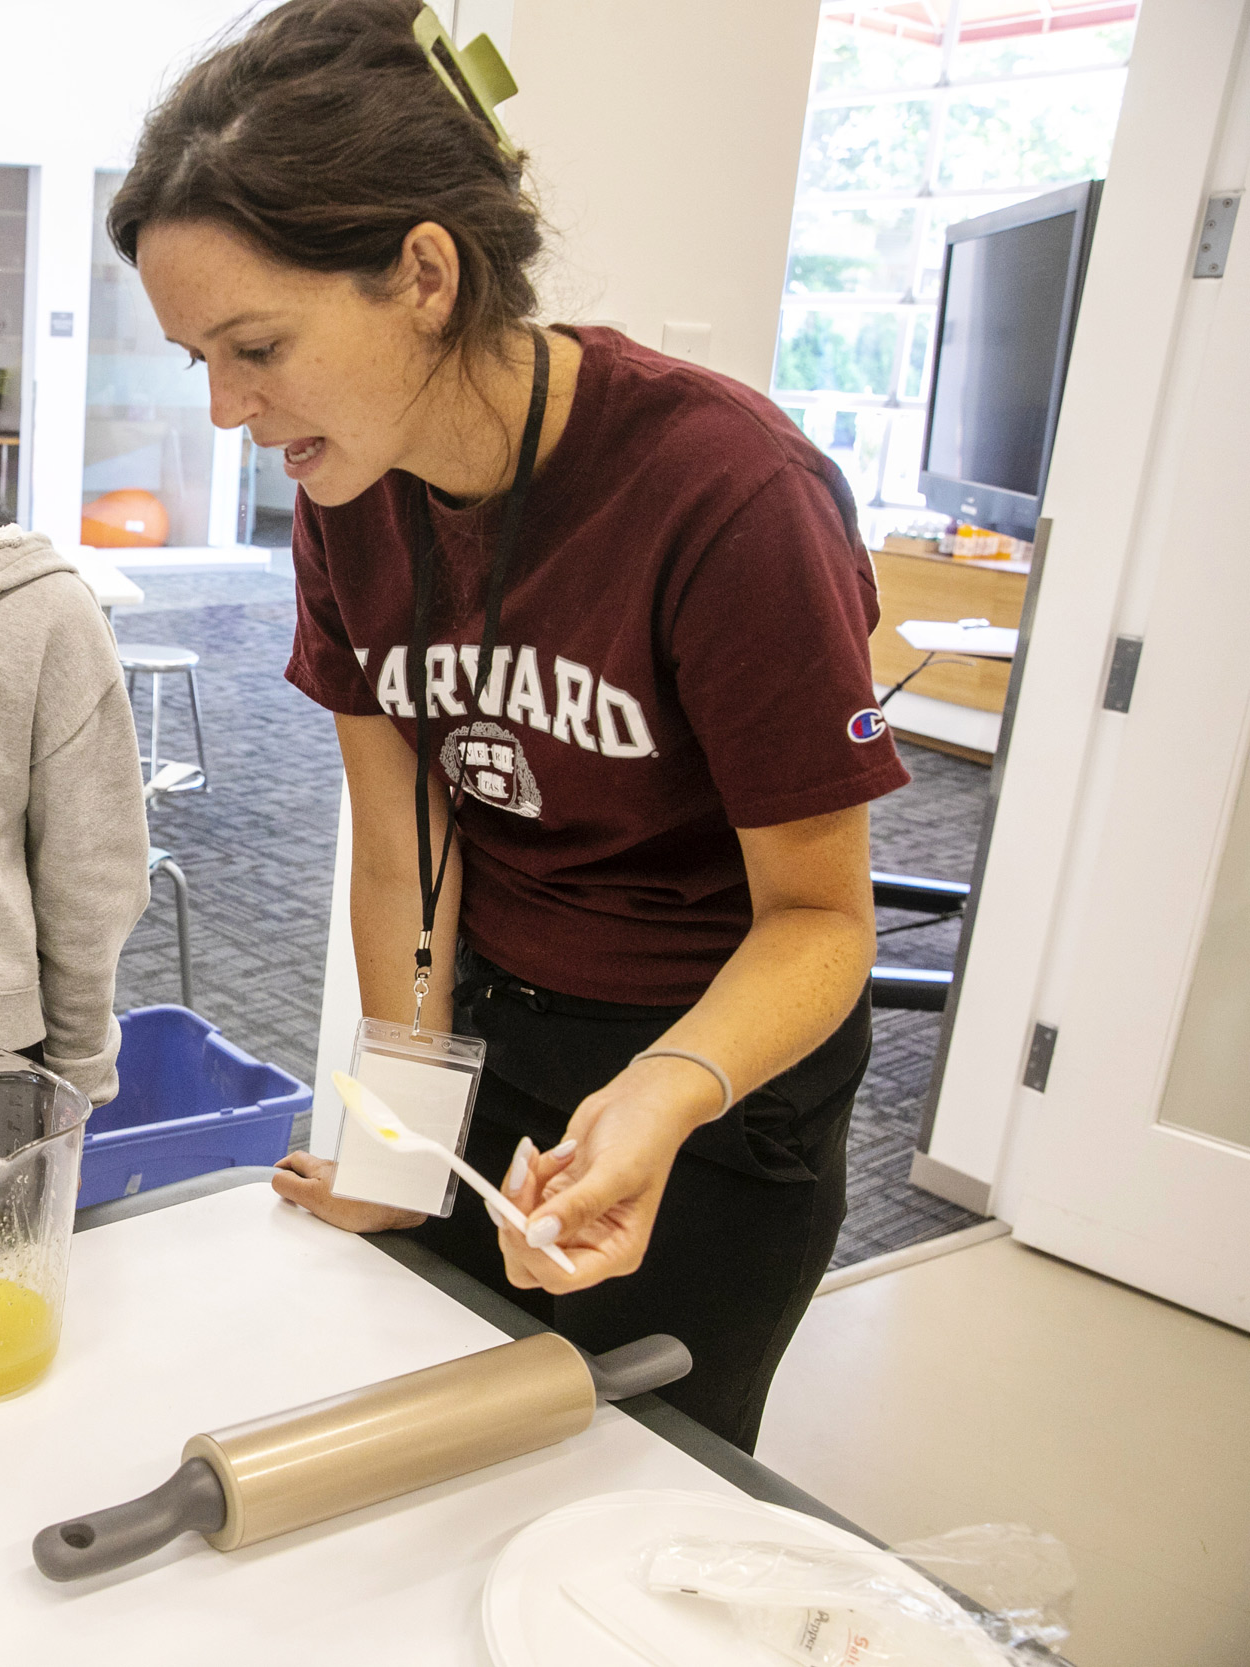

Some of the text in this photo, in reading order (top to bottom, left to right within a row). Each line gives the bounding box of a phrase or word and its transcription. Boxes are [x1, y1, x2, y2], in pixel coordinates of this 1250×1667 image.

[354, 643, 657, 759] ARVARD
[483, 780, 500, 791] TAS
[805, 1610, 830, 1652] Pepper
[846, 1634, 869, 1665] Salt
